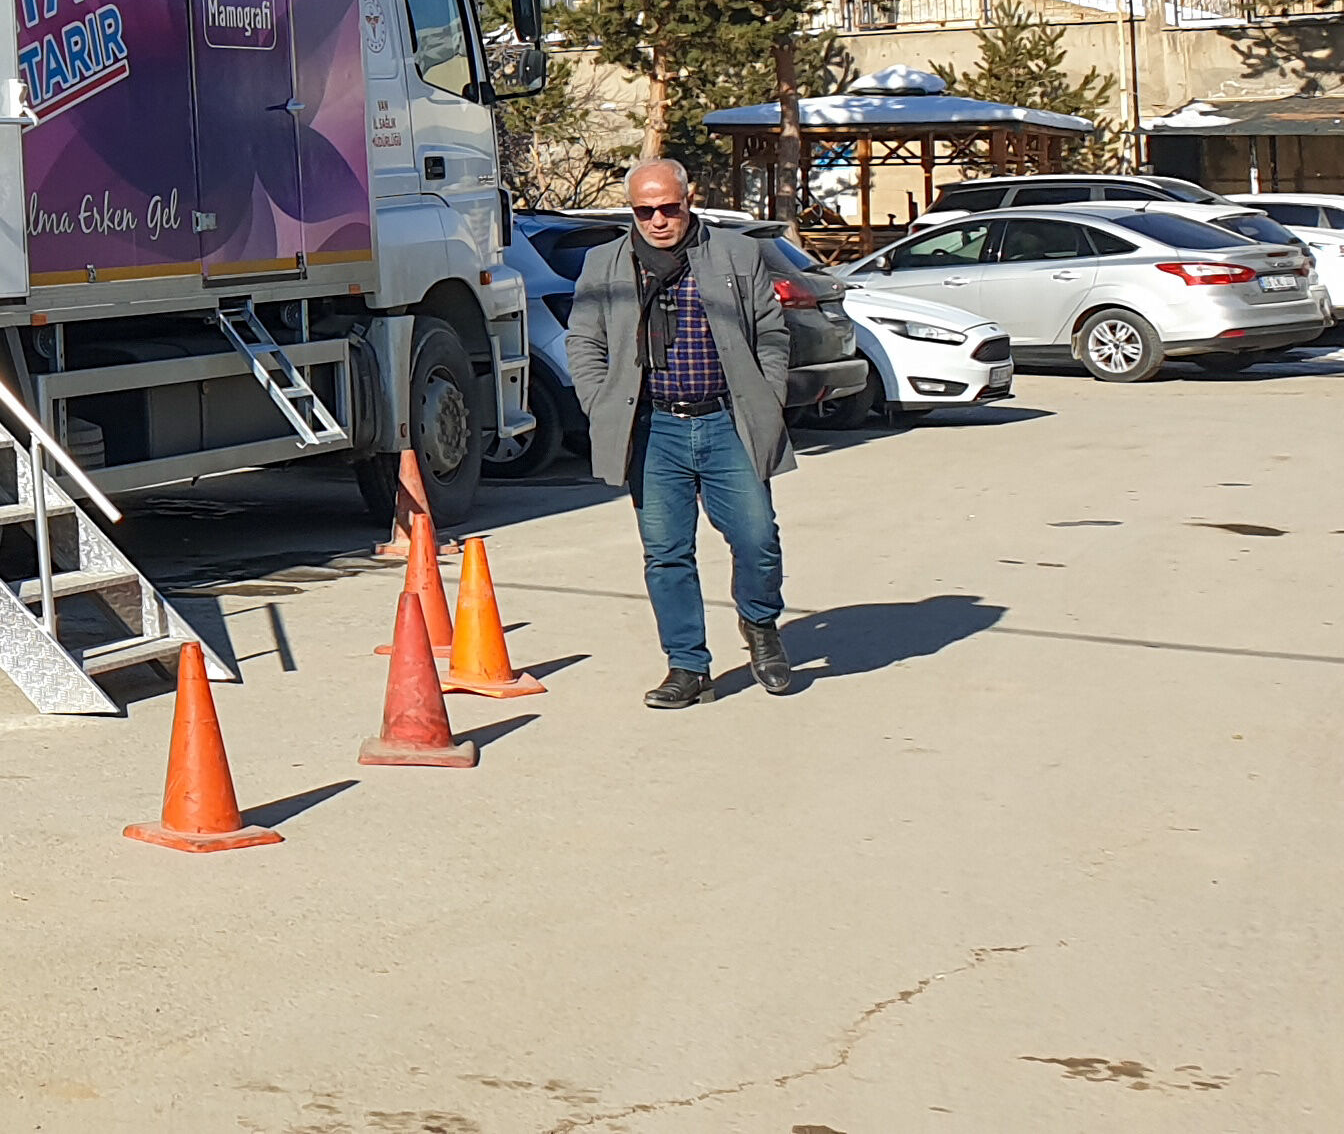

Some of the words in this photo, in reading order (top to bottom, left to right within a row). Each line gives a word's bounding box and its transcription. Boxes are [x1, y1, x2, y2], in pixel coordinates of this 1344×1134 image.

[18, 4, 128, 106] TARIR
[26, 192, 75, 236] lma
[78, 190, 138, 236] Erken
[147, 187, 181, 241] Gel
